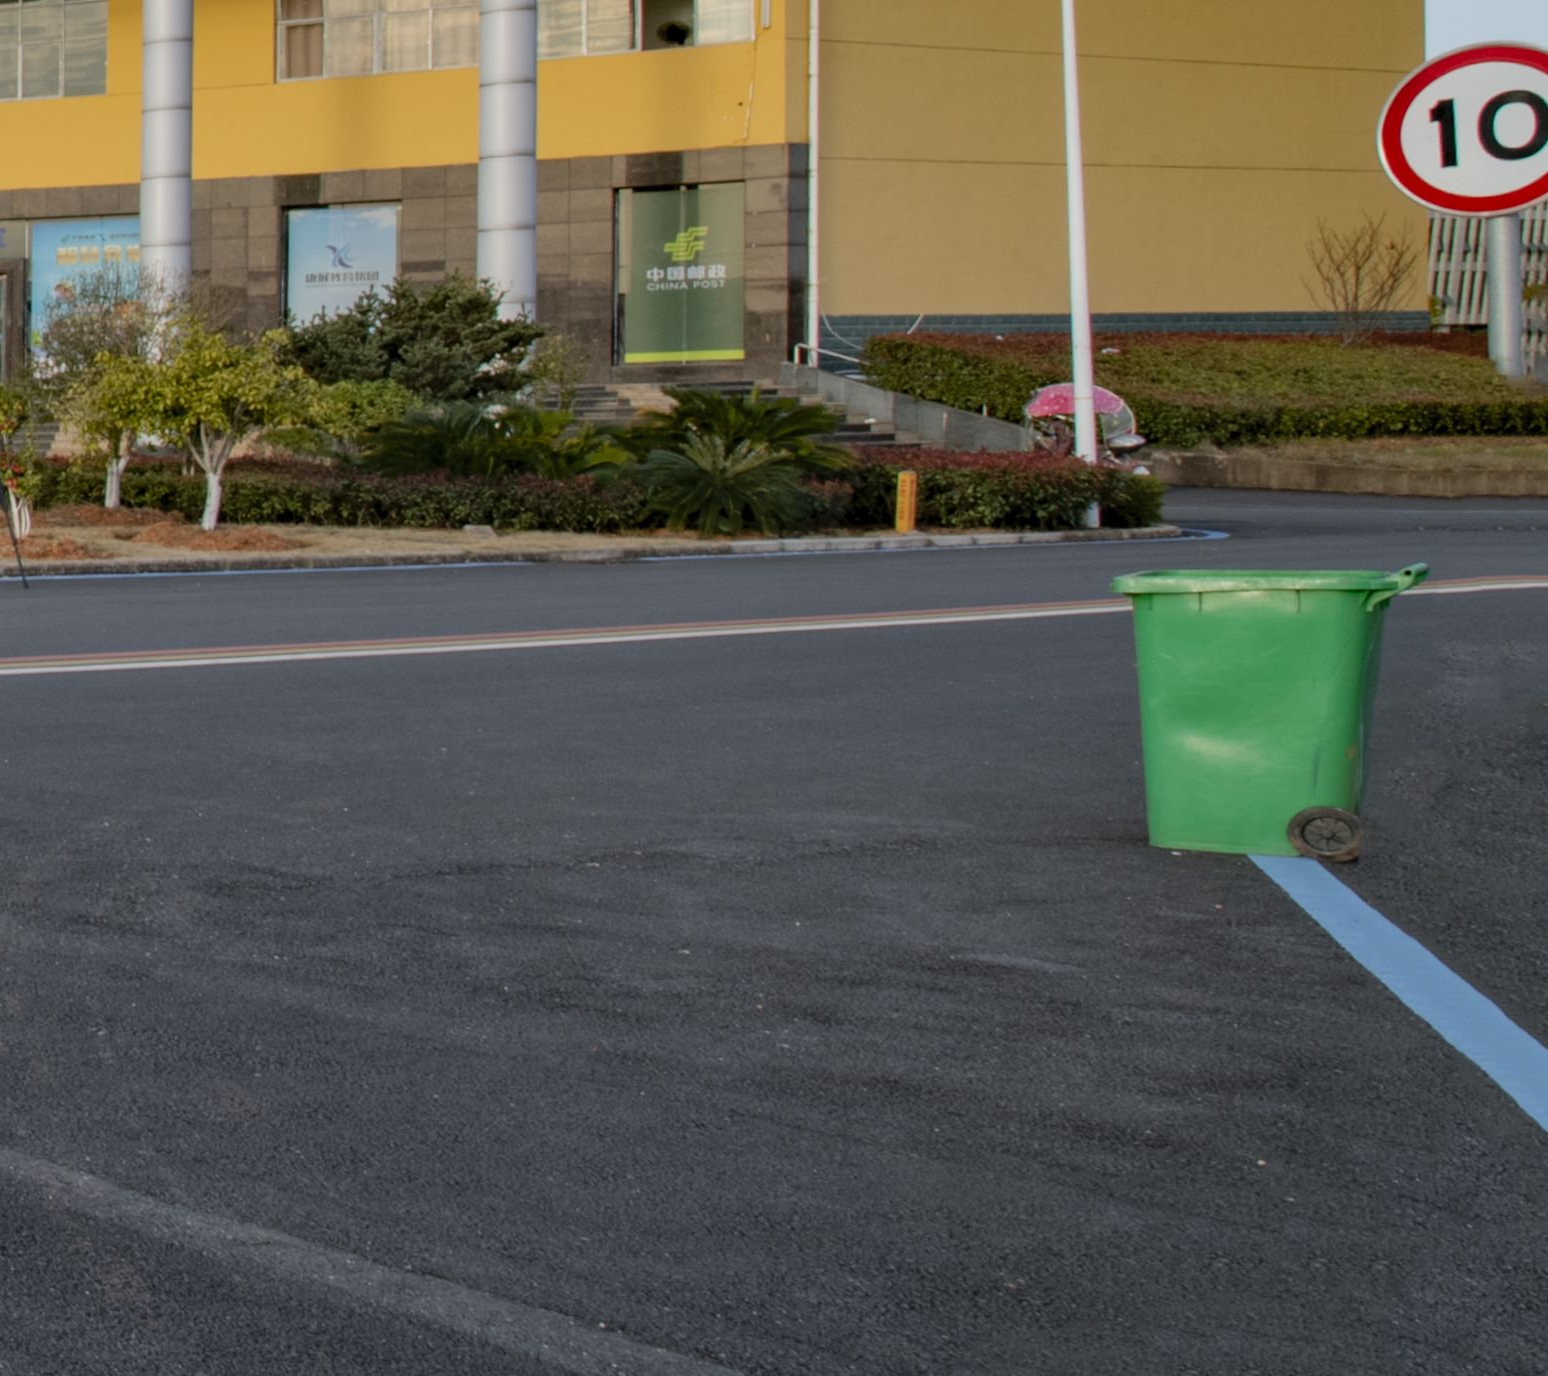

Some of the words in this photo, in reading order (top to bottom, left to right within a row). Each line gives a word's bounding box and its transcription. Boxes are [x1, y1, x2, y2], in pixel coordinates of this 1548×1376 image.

[1429, 90, 1548, 168] 10
[646, 264, 726, 282] 中国邮政
[646, 281, 688, 291] CHINA
[693, 279, 726, 289] POST
